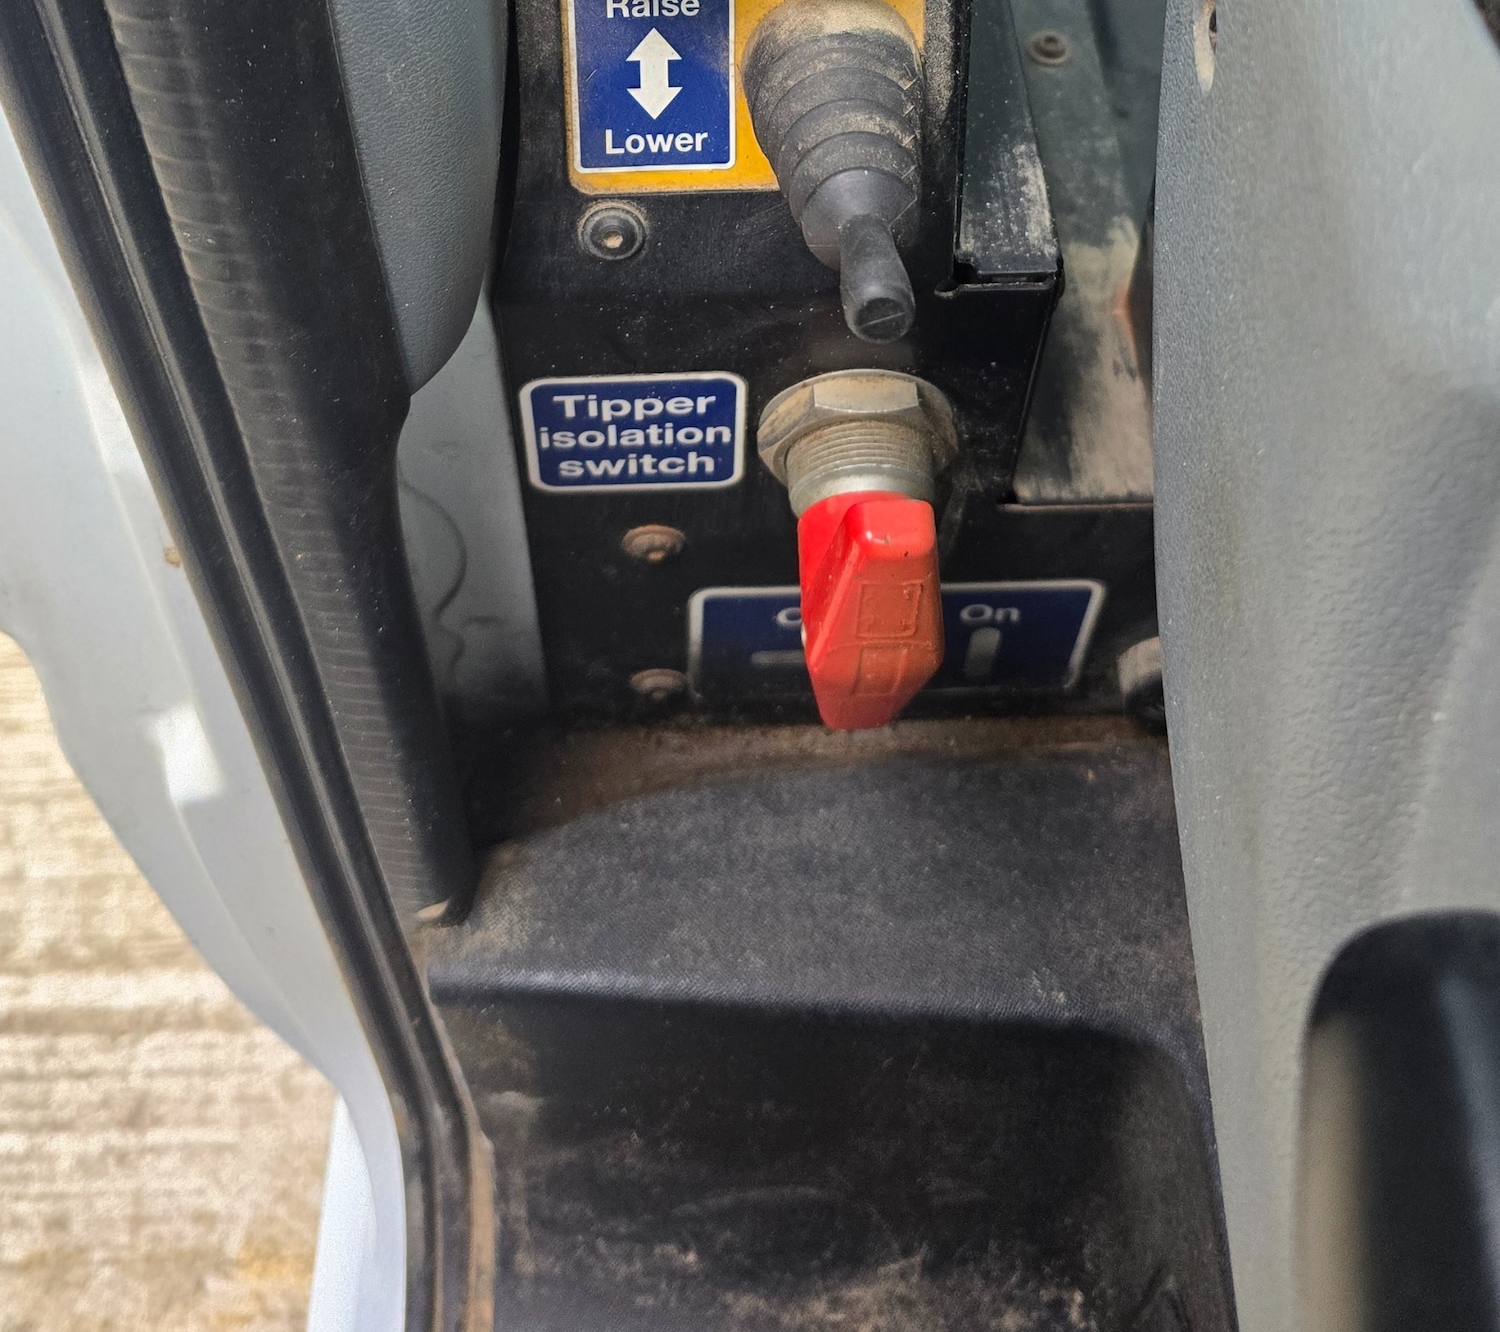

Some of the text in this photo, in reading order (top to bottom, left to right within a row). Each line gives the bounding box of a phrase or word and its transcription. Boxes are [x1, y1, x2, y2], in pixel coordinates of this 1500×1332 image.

[605, 129, 708, 155] Lower
[552, 393, 717, 422] Tipper
[540, 421, 732, 449] isolation
[558, 450, 715, 478] switch
[959, 603, 1020, 623] On
